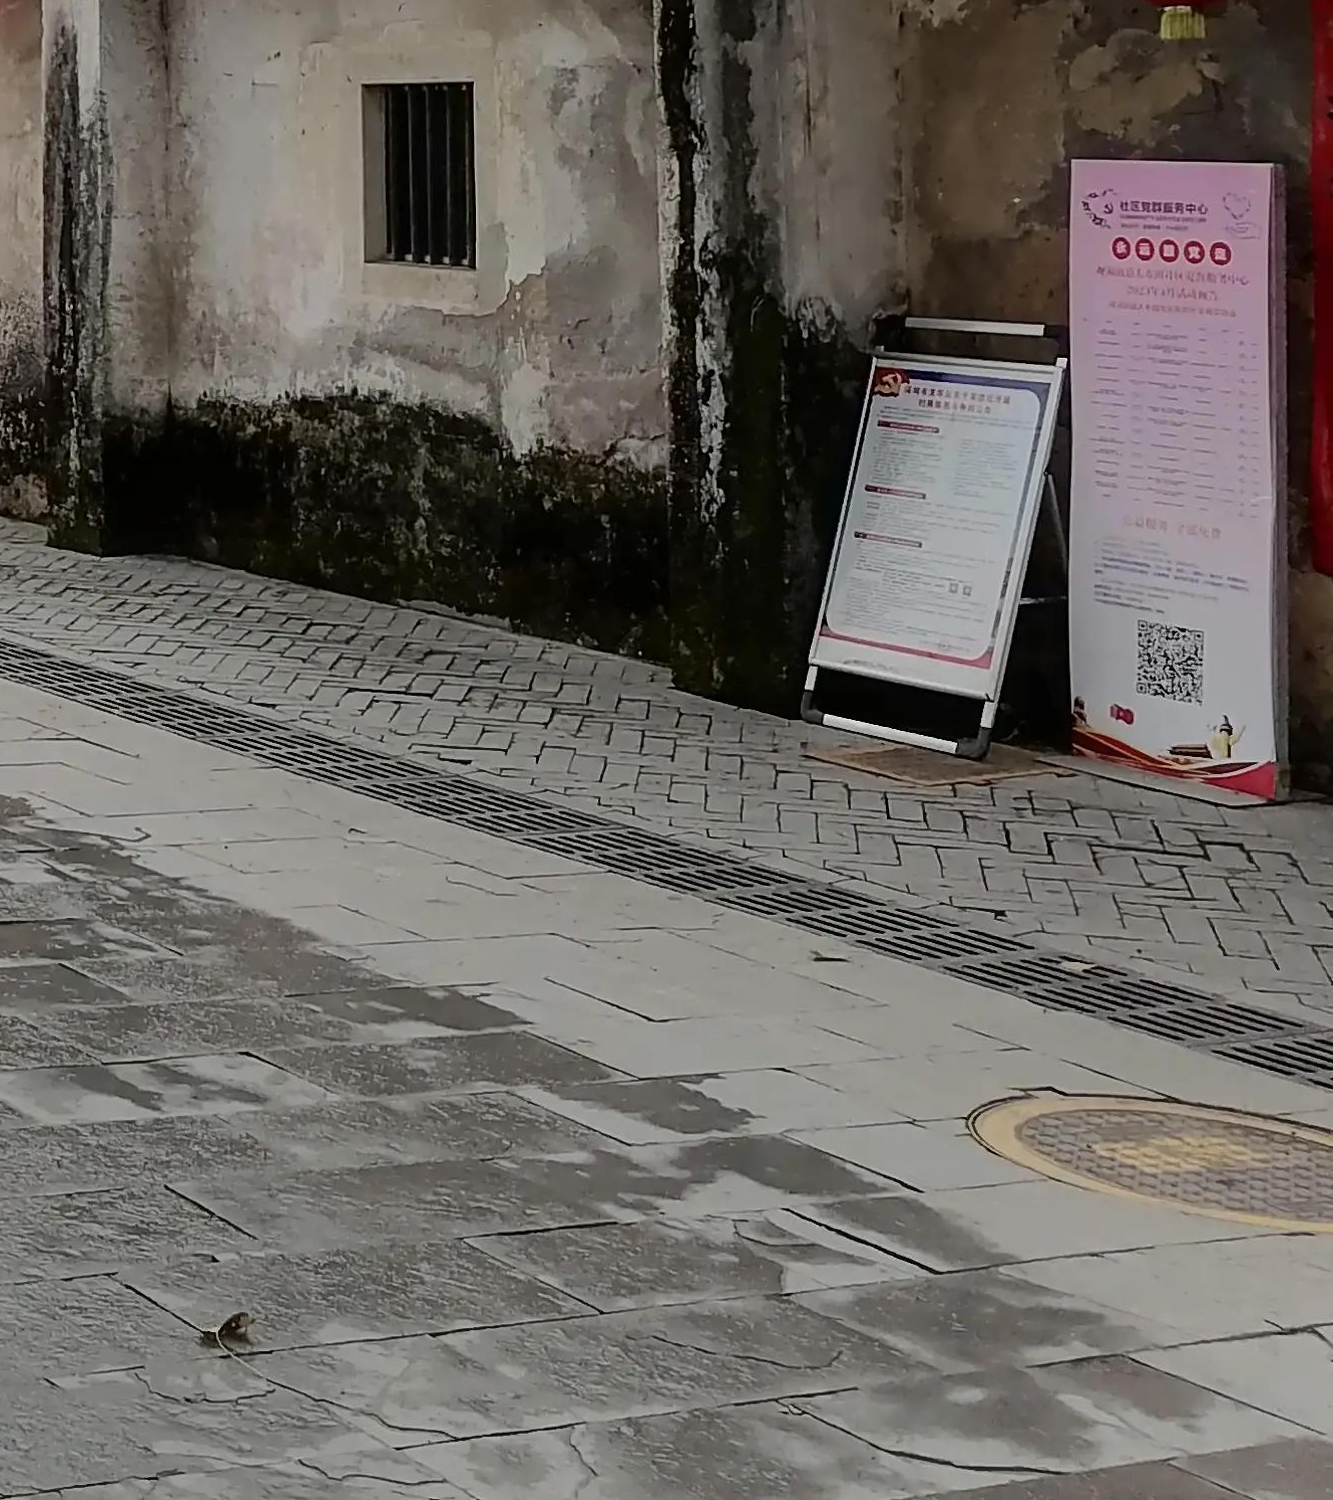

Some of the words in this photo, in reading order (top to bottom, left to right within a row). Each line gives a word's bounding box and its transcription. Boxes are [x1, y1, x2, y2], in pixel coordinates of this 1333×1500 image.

[1119, 200, 1209, 216] 社区党群服务中心
